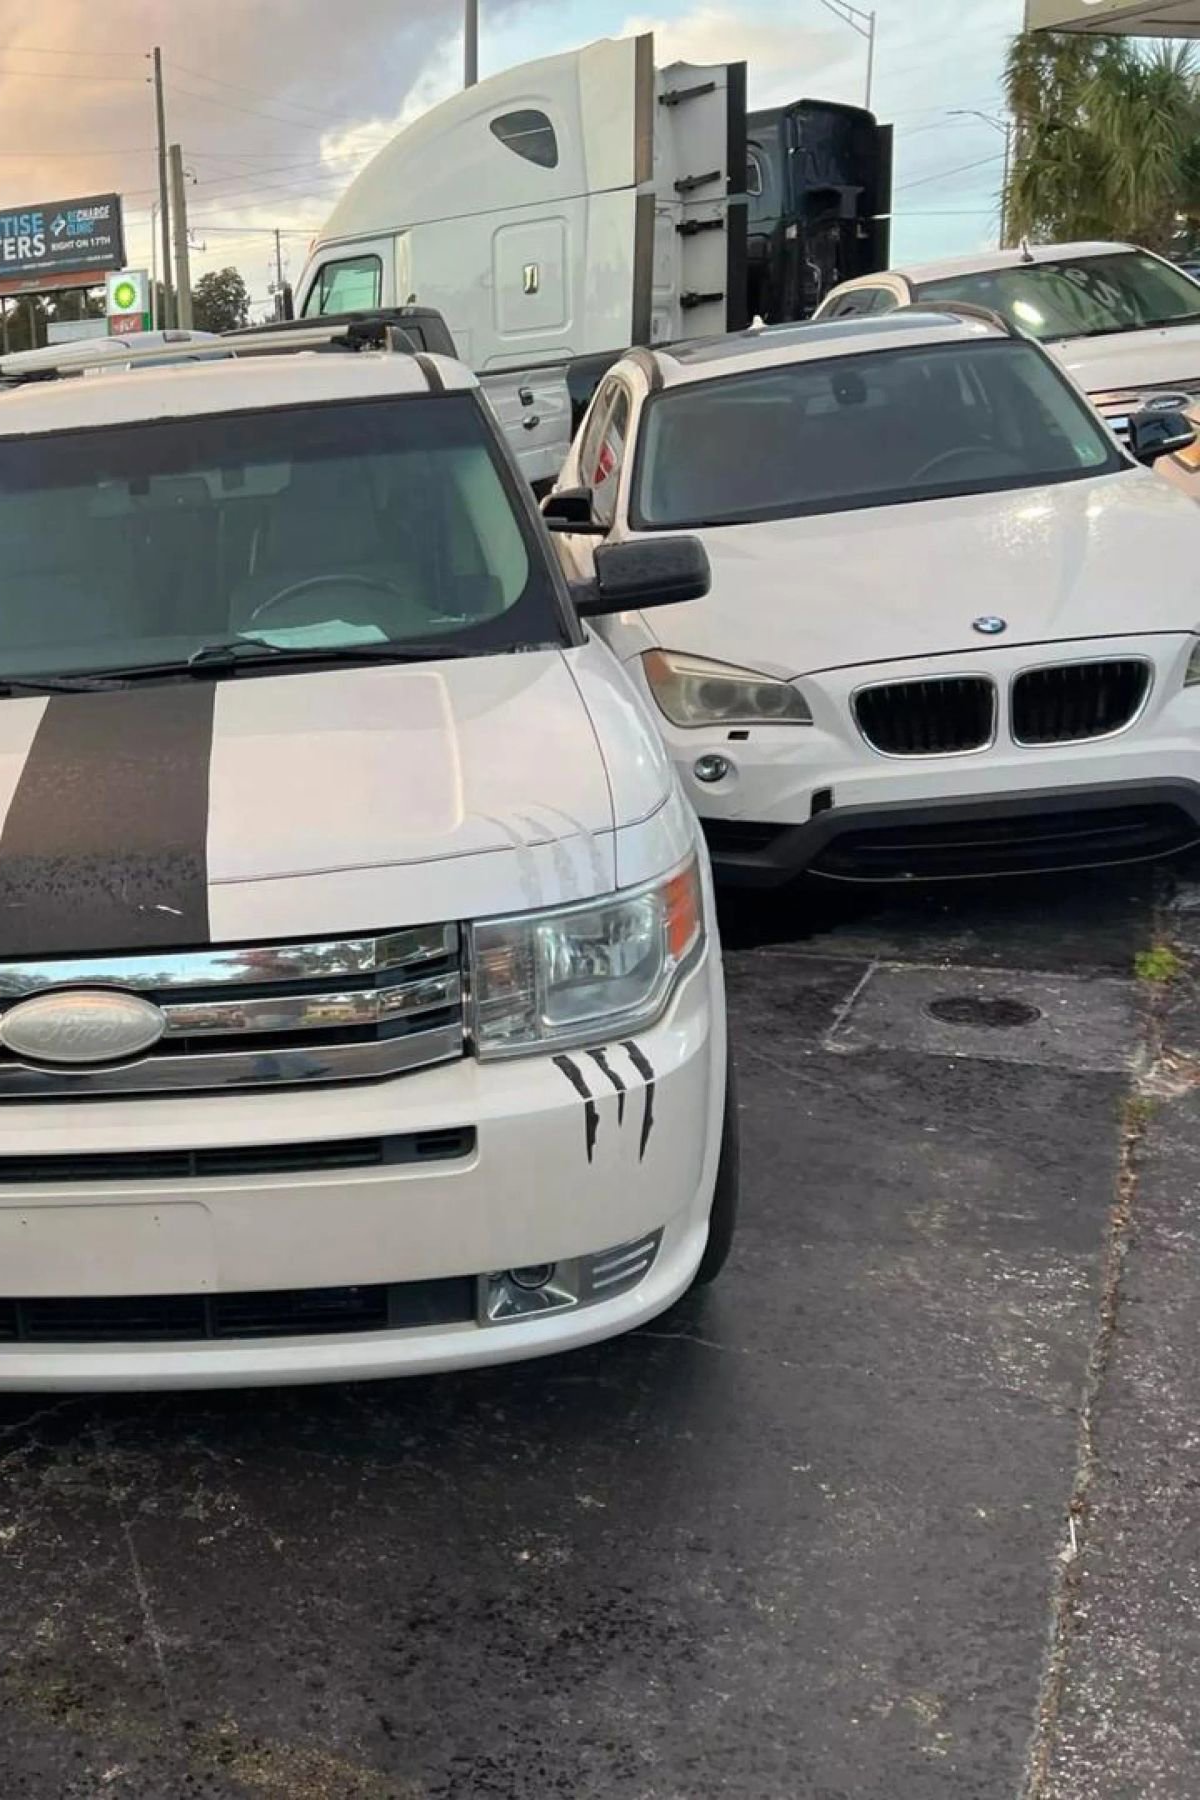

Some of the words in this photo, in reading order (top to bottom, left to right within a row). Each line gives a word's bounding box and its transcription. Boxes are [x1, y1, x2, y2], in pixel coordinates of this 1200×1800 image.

[51, 240, 74, 252] RIGHT
[75, 239, 89, 249] ON
[90, 235, 111, 247] 17TH
